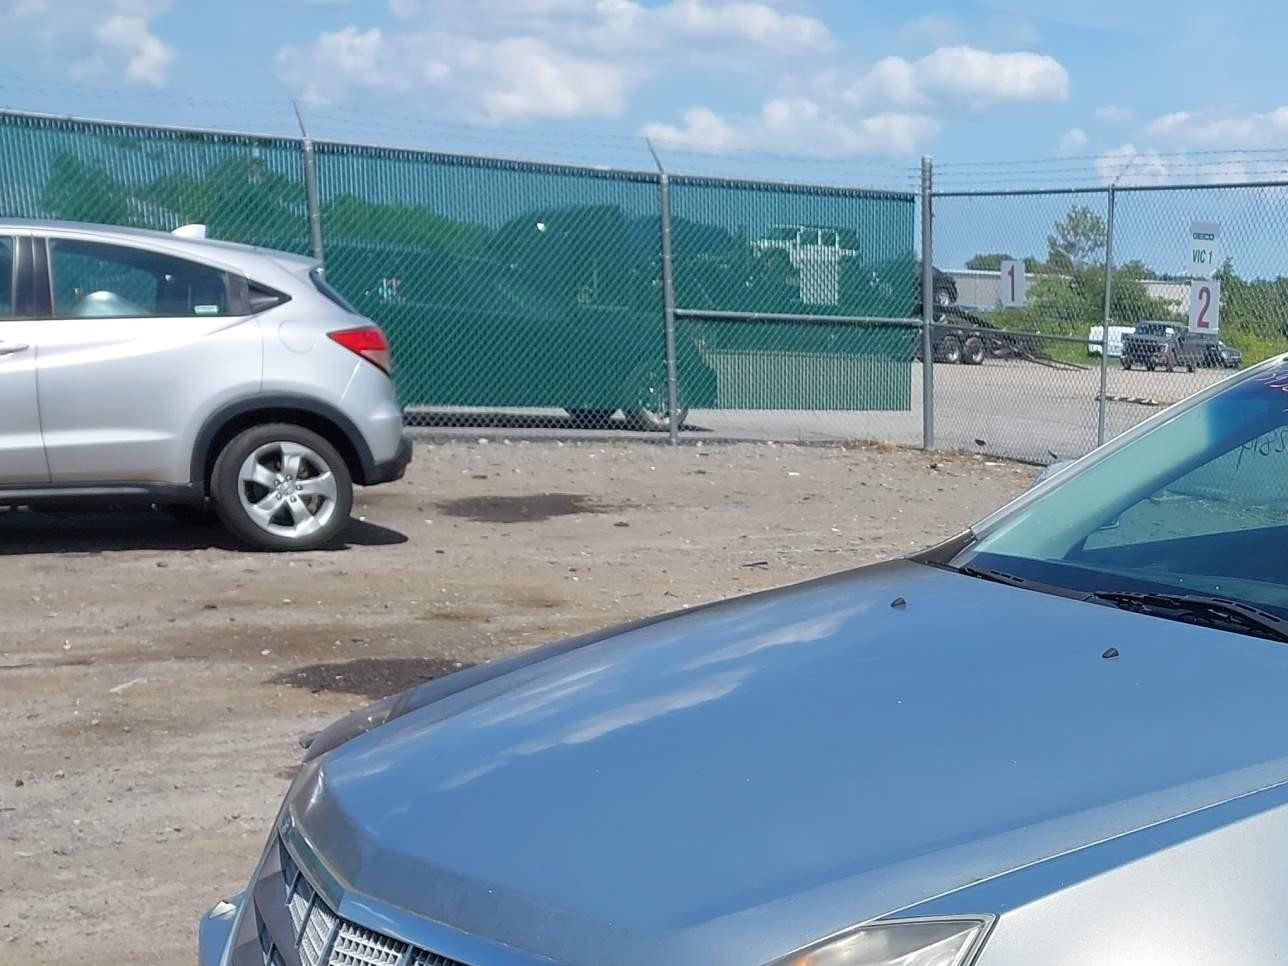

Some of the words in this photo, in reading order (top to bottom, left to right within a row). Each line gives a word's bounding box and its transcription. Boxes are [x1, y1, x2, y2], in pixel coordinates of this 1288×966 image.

[1193, 249, 1206, 264] VIC
[1208, 250, 1213, 264] 1
[1007, 264, 1015, 302] 1
[1197, 286, 1211, 329] 2
